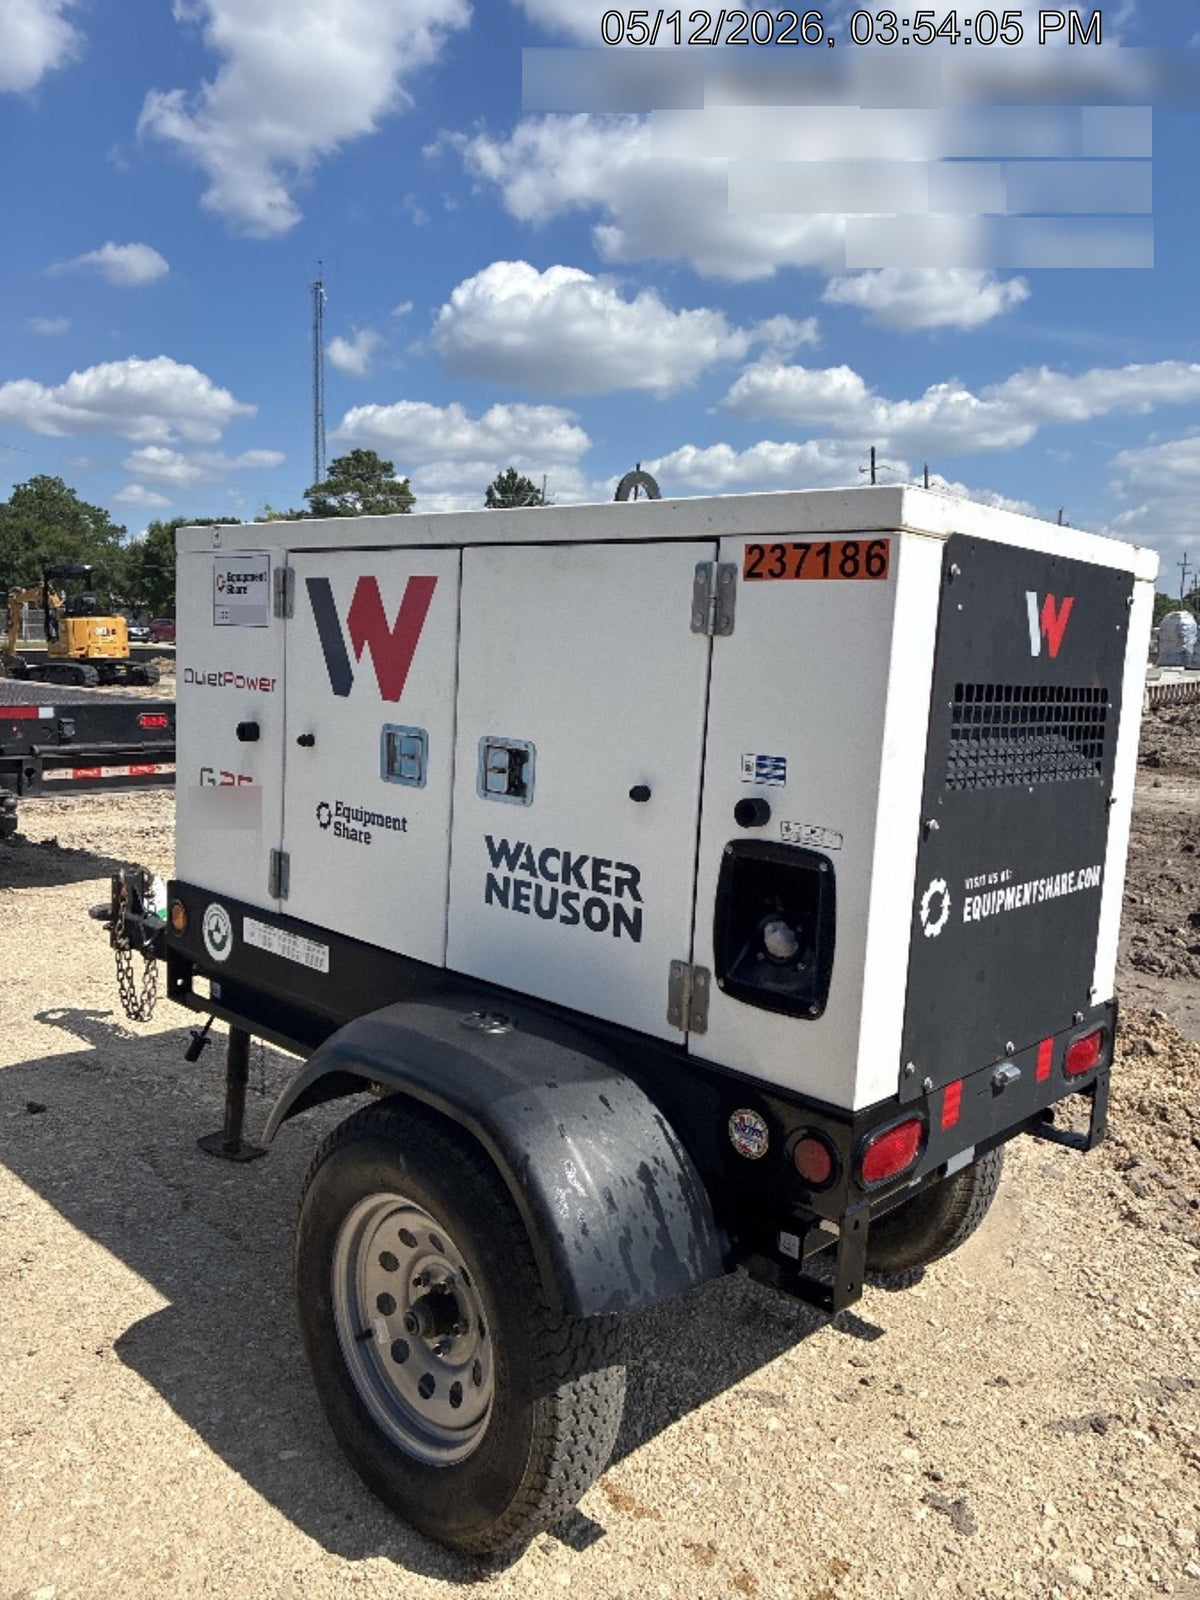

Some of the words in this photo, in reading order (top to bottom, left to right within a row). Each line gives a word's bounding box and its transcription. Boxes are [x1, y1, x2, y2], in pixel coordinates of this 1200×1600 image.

[745, 540, 886, 579] 237186
[333, 820, 372, 845] Share
[335, 800, 408, 833] Equipment
[484, 834, 644, 904] WACKER
[484, 872, 643, 943] NEUSON
[963, 865, 1102, 923] EQUIPMENTSHARE.COM
